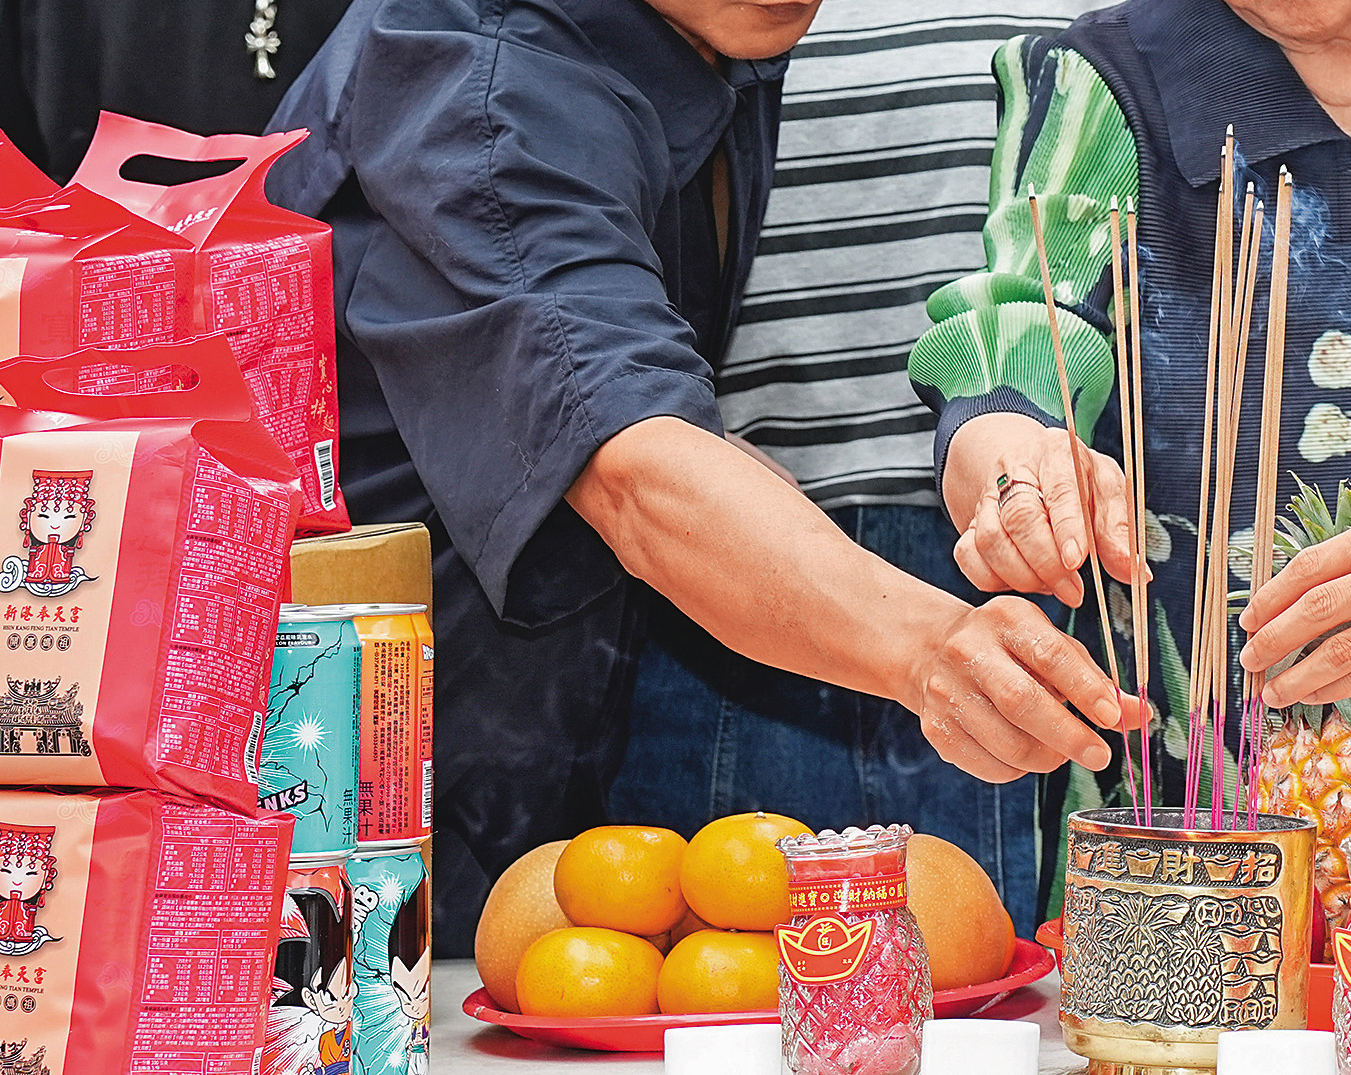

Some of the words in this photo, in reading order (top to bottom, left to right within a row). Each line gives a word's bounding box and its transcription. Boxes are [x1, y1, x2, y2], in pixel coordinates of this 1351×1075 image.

[4, 605, 83, 623] 新港奉天宮
[0, 964, 47, 985] 奉天宮
